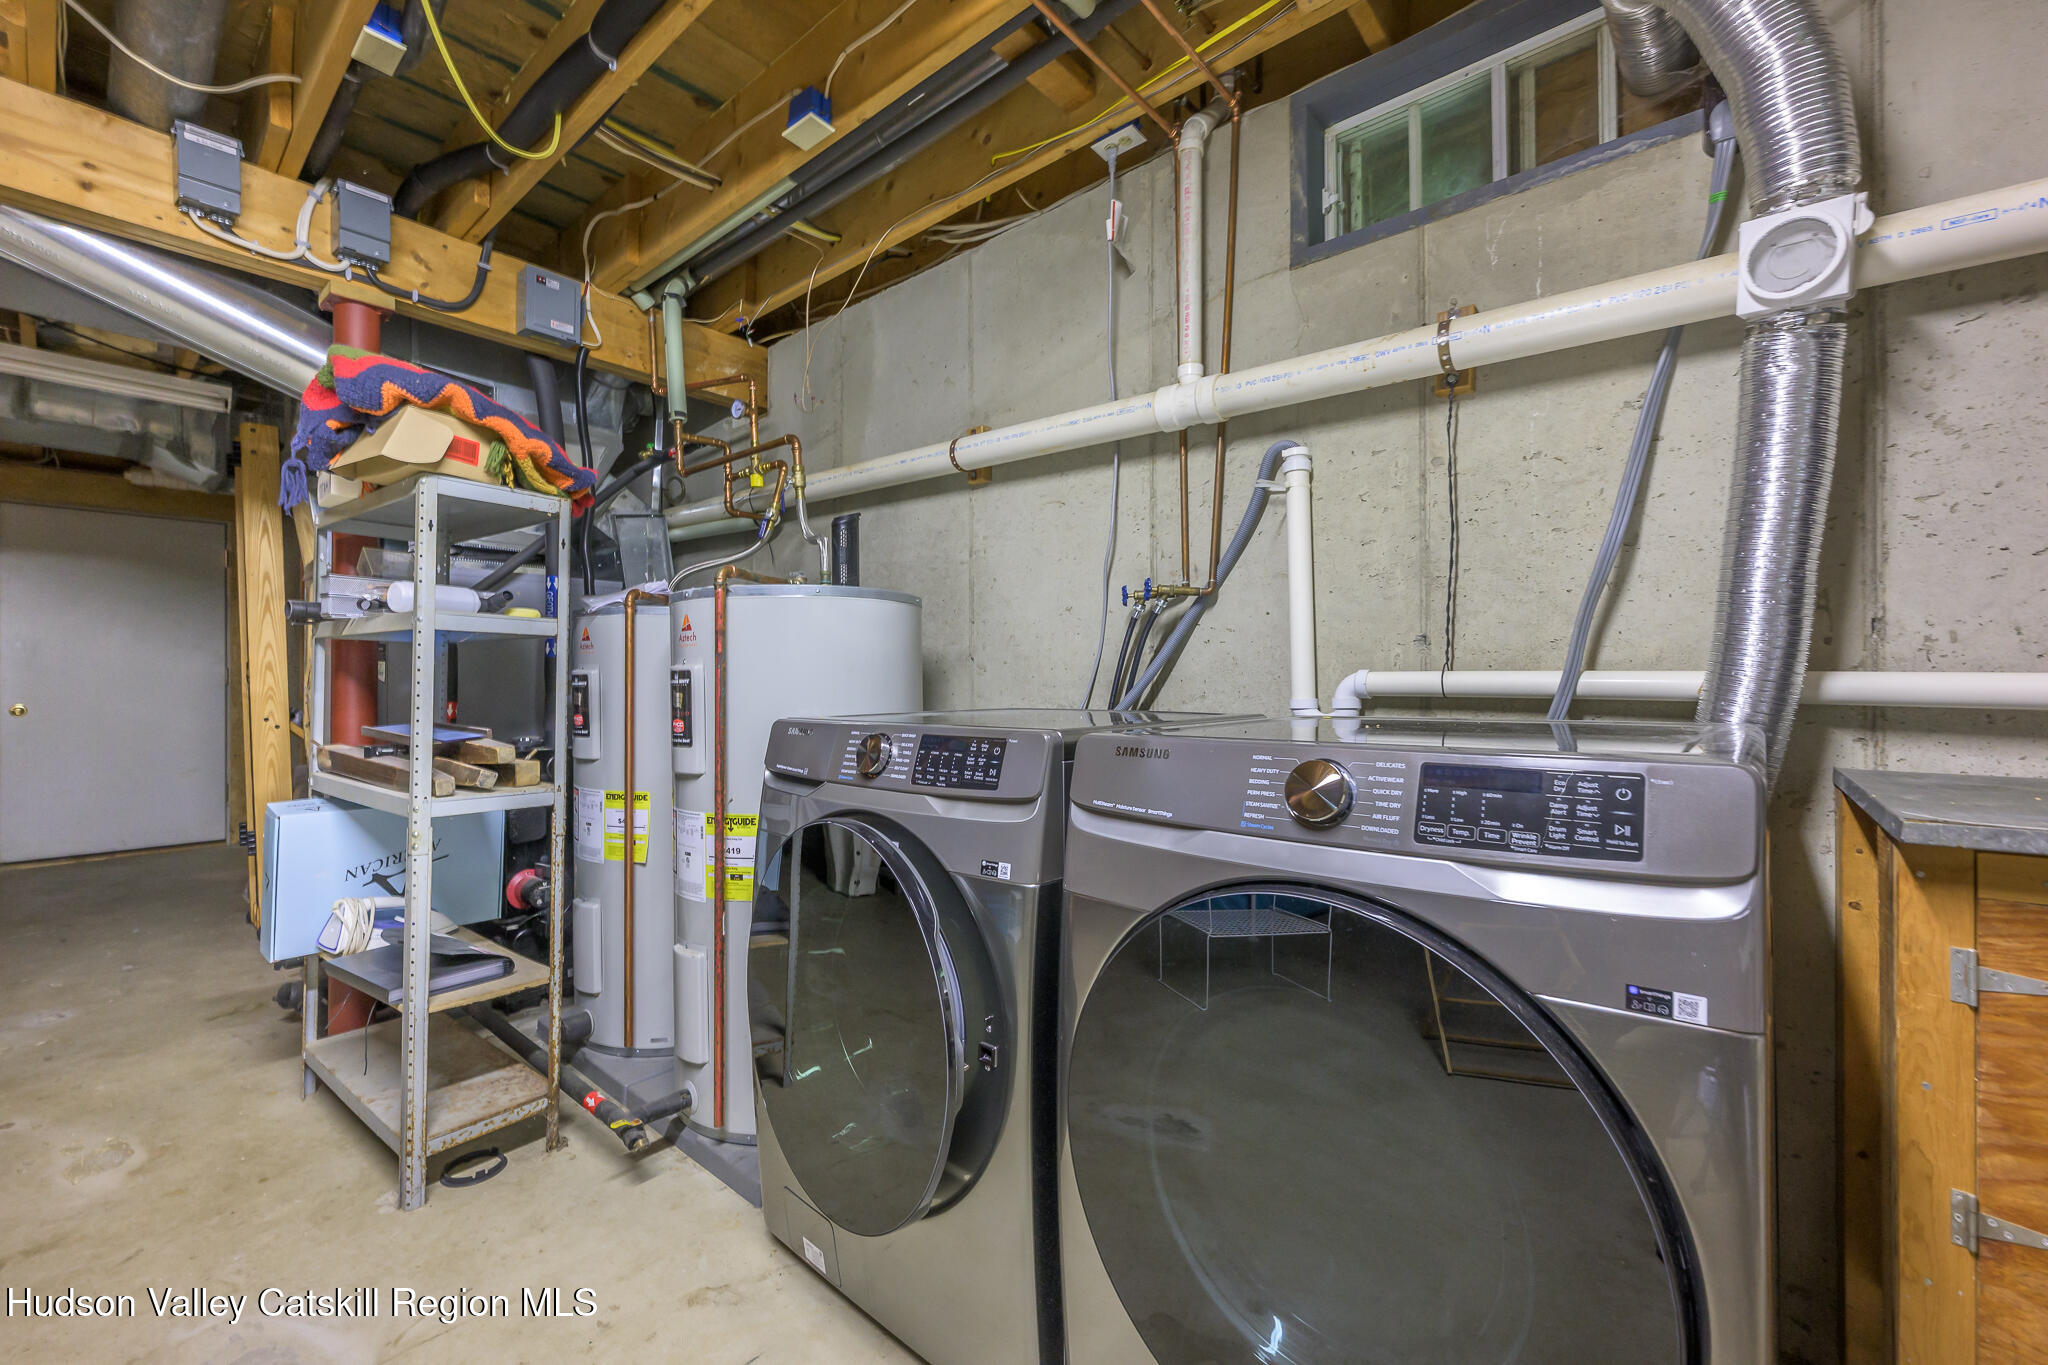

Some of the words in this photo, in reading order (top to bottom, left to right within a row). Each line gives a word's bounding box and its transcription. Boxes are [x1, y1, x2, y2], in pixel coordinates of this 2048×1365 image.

[679, 632, 697, 642] Aztech
[1115, 746, 1171, 760] SAMSUNG
[1375, 761, 1406, 769] DELICATES
[1367, 775, 1404, 783] ACTIVEWEAR
[1577, 781, 1599, 789] Adjust
[1549, 802, 1569, 810] Damp
[1576, 804, 1598, 812] Adjust
[1361, 825, 1400, 835] DOWNLOADED
[1420, 825, 1445, 834] Dryness
[1452, 828, 1471, 837] Temp.
[1548, 825, 1567, 833] Drum
[1576, 828, 1598, 836] Smart
[1484, 831, 1500, 839] Time
[1512, 832, 1537, 840] Wrinkle
[1549, 832, 1566, 840] Light
[1574, 835, 1600, 843] Control
[1511, 838, 1537, 846] Prevent
[344, 838, 442, 882] ARICAN
